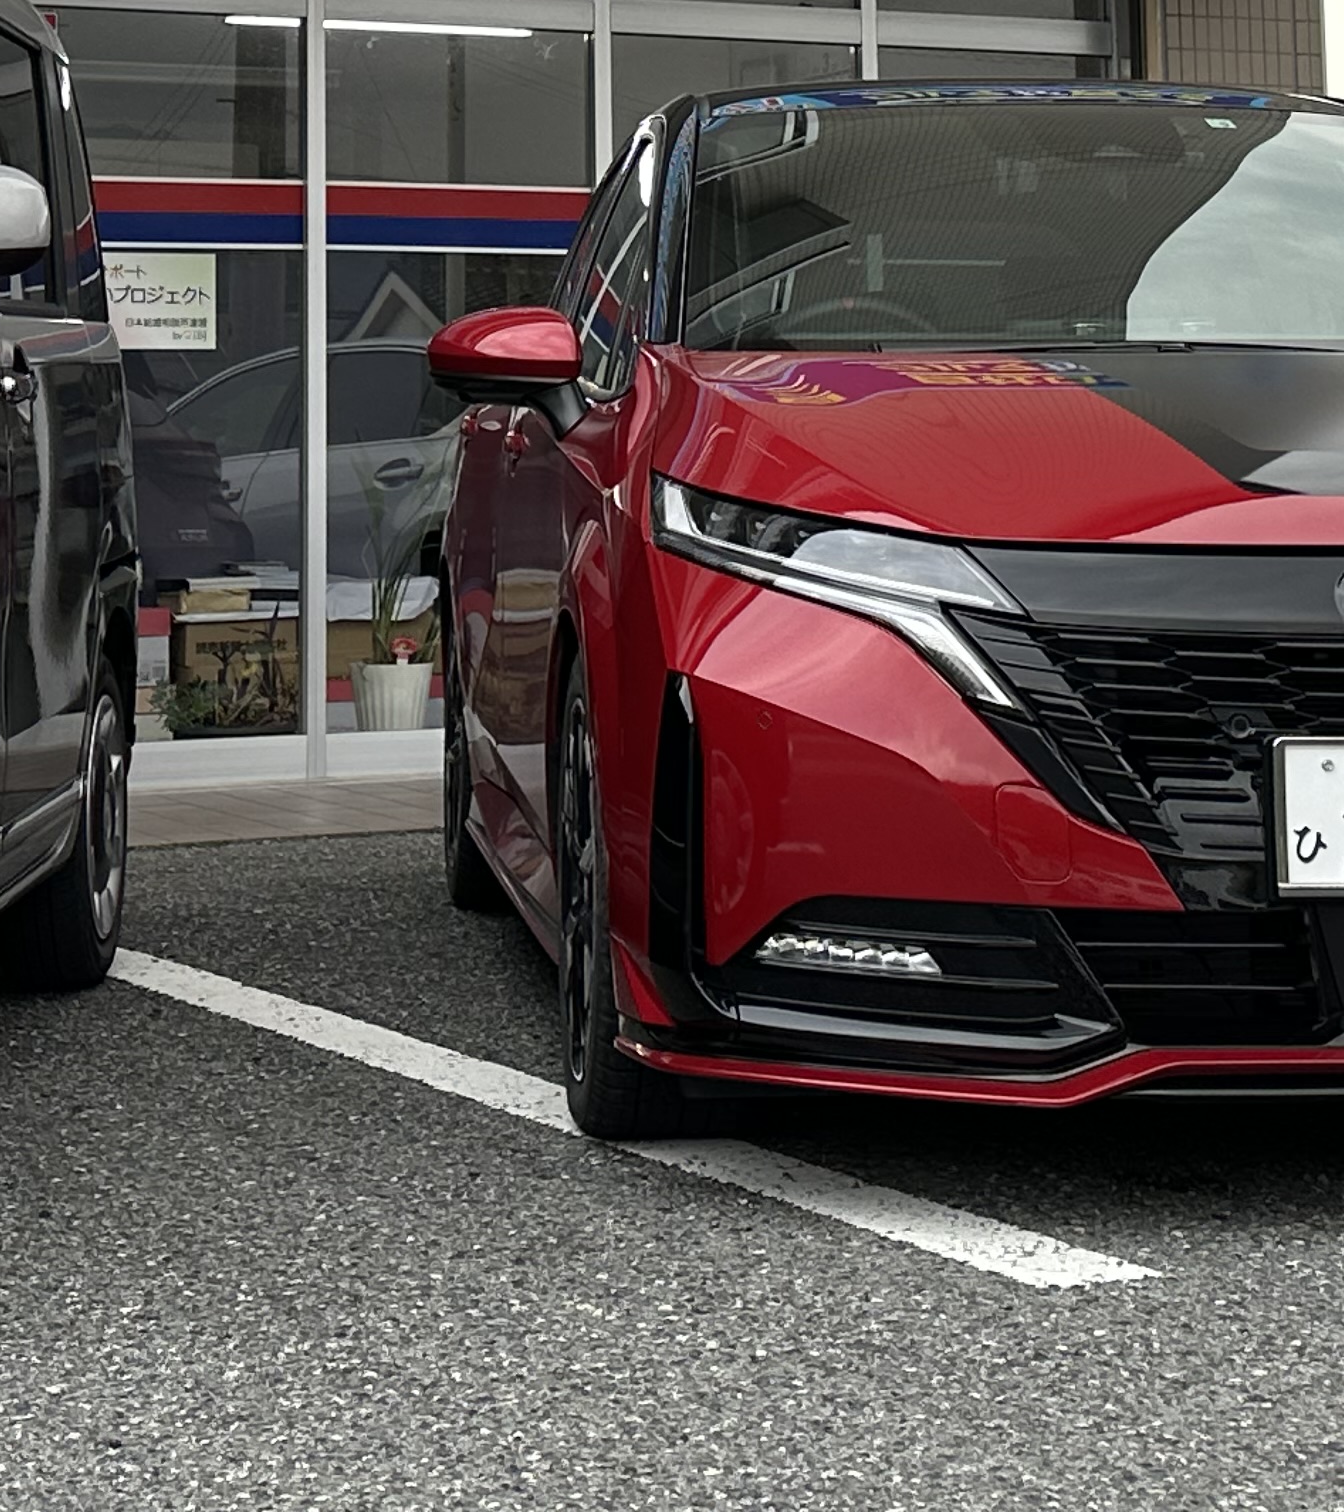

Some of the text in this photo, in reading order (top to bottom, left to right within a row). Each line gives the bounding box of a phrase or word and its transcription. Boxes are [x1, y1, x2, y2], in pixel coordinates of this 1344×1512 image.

[104, 263, 147, 279] ポート
[1293, 825, 1327, 864] ひ
